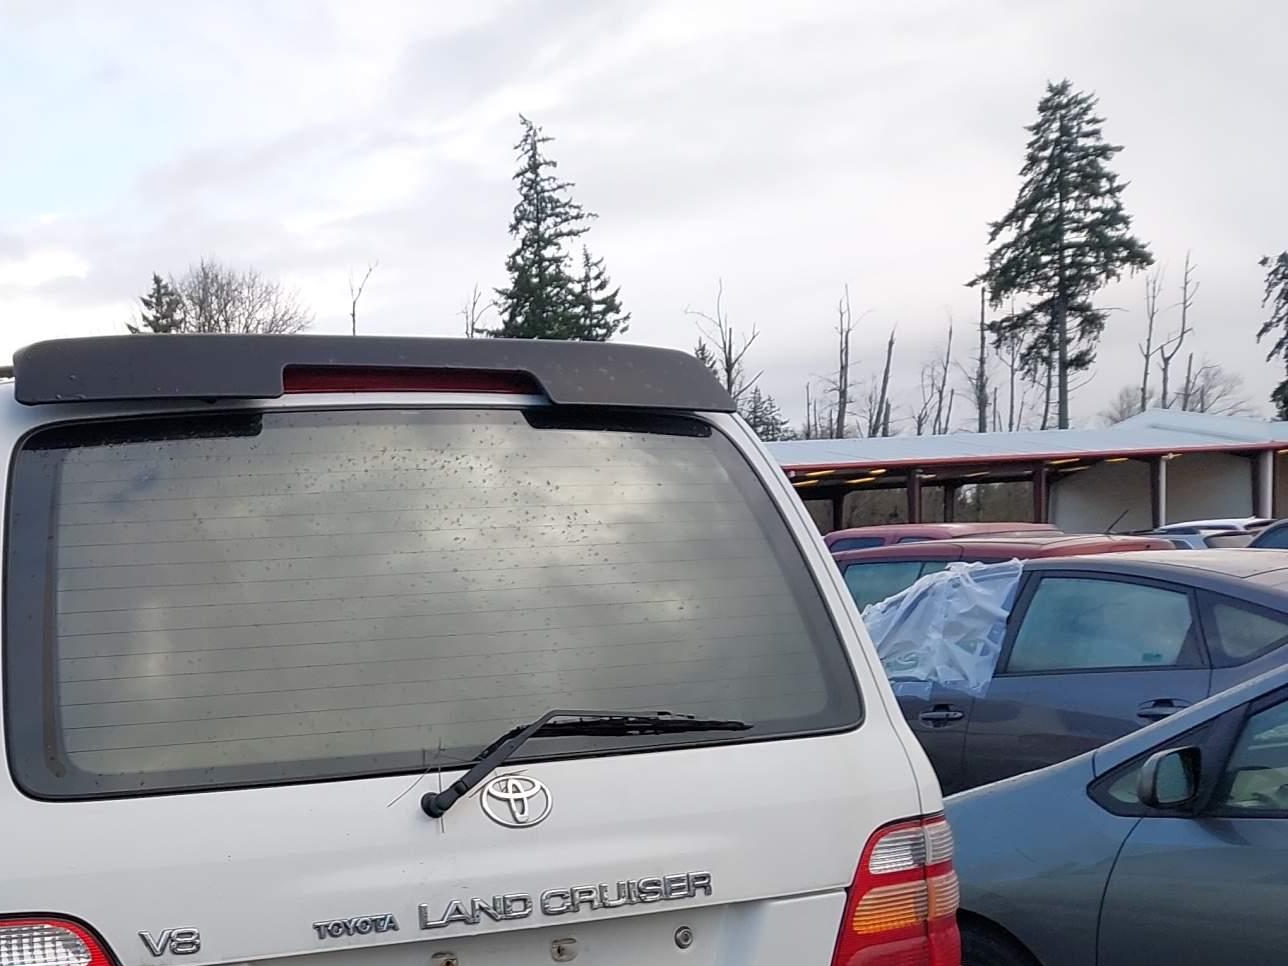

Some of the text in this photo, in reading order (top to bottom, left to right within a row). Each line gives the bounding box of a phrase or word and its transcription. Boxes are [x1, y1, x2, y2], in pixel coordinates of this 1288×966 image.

[313, 870, 712, 940] TOYOTA LAND CRUISER
[138, 927, 202, 957] V8
